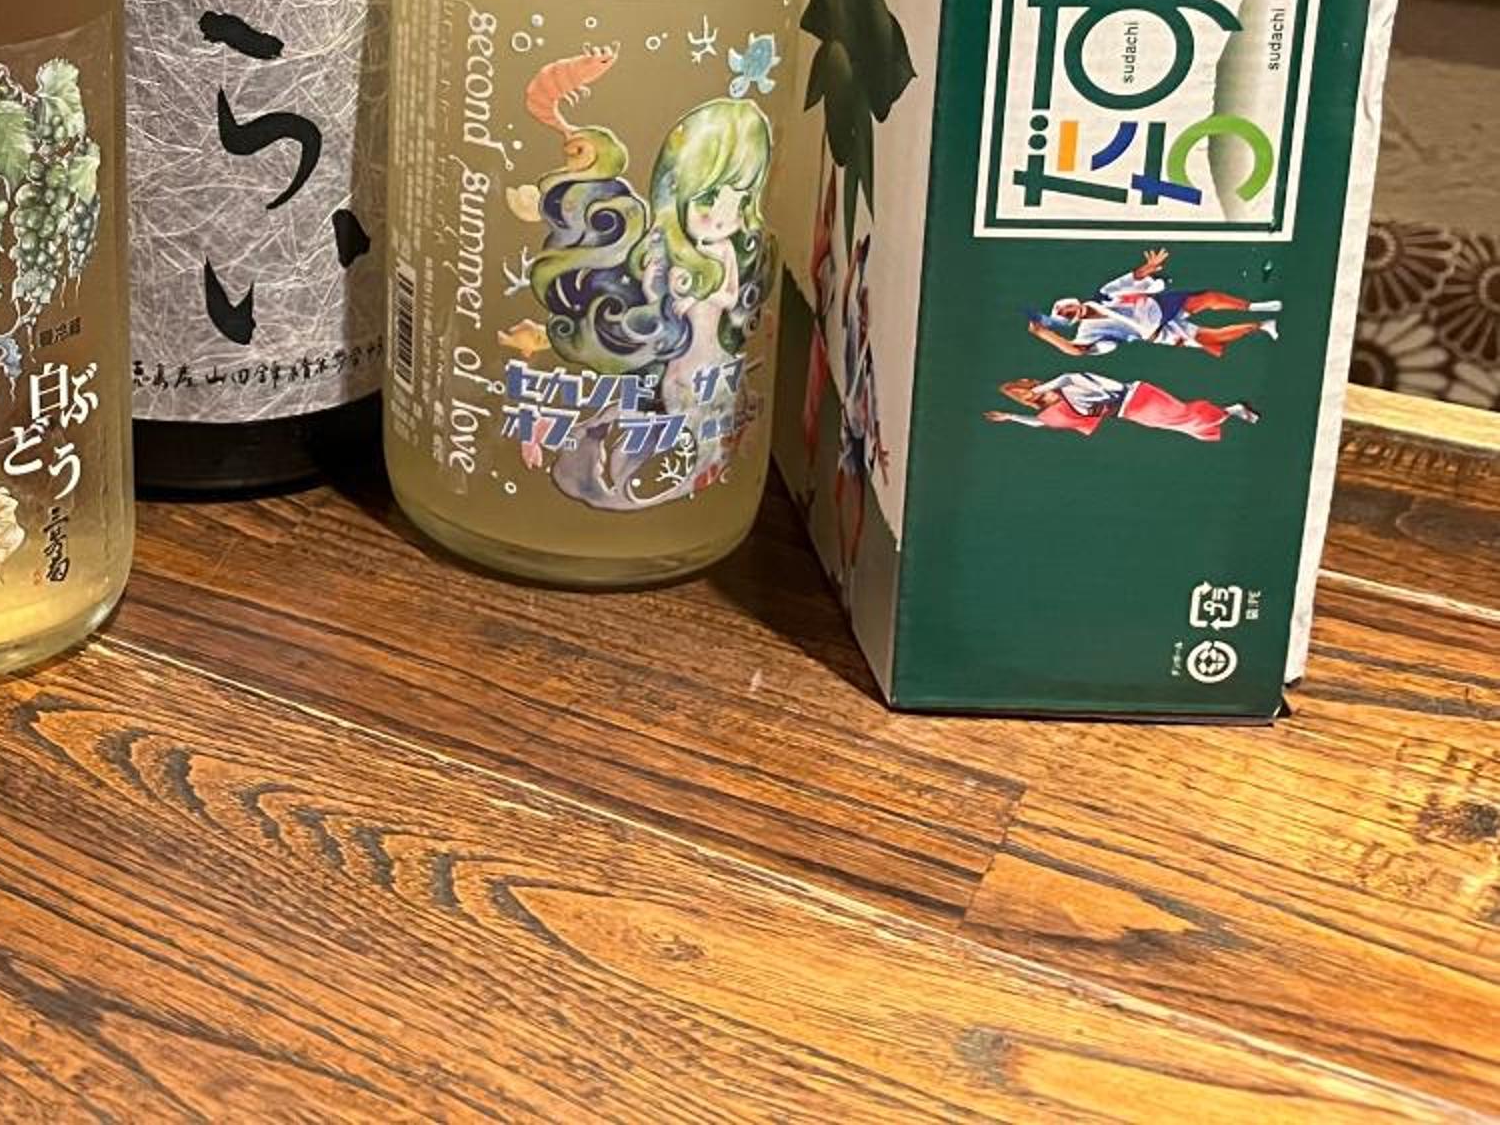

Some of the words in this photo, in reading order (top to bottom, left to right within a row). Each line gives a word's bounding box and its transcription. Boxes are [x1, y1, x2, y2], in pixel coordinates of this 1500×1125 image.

[1123, 21, 1139, 84] sudachi
[1267, 7, 1286, 71] sudachi
[445, 155, 492, 329] summer
[453, 346, 506, 393] of
[449, 398, 491, 474] love
